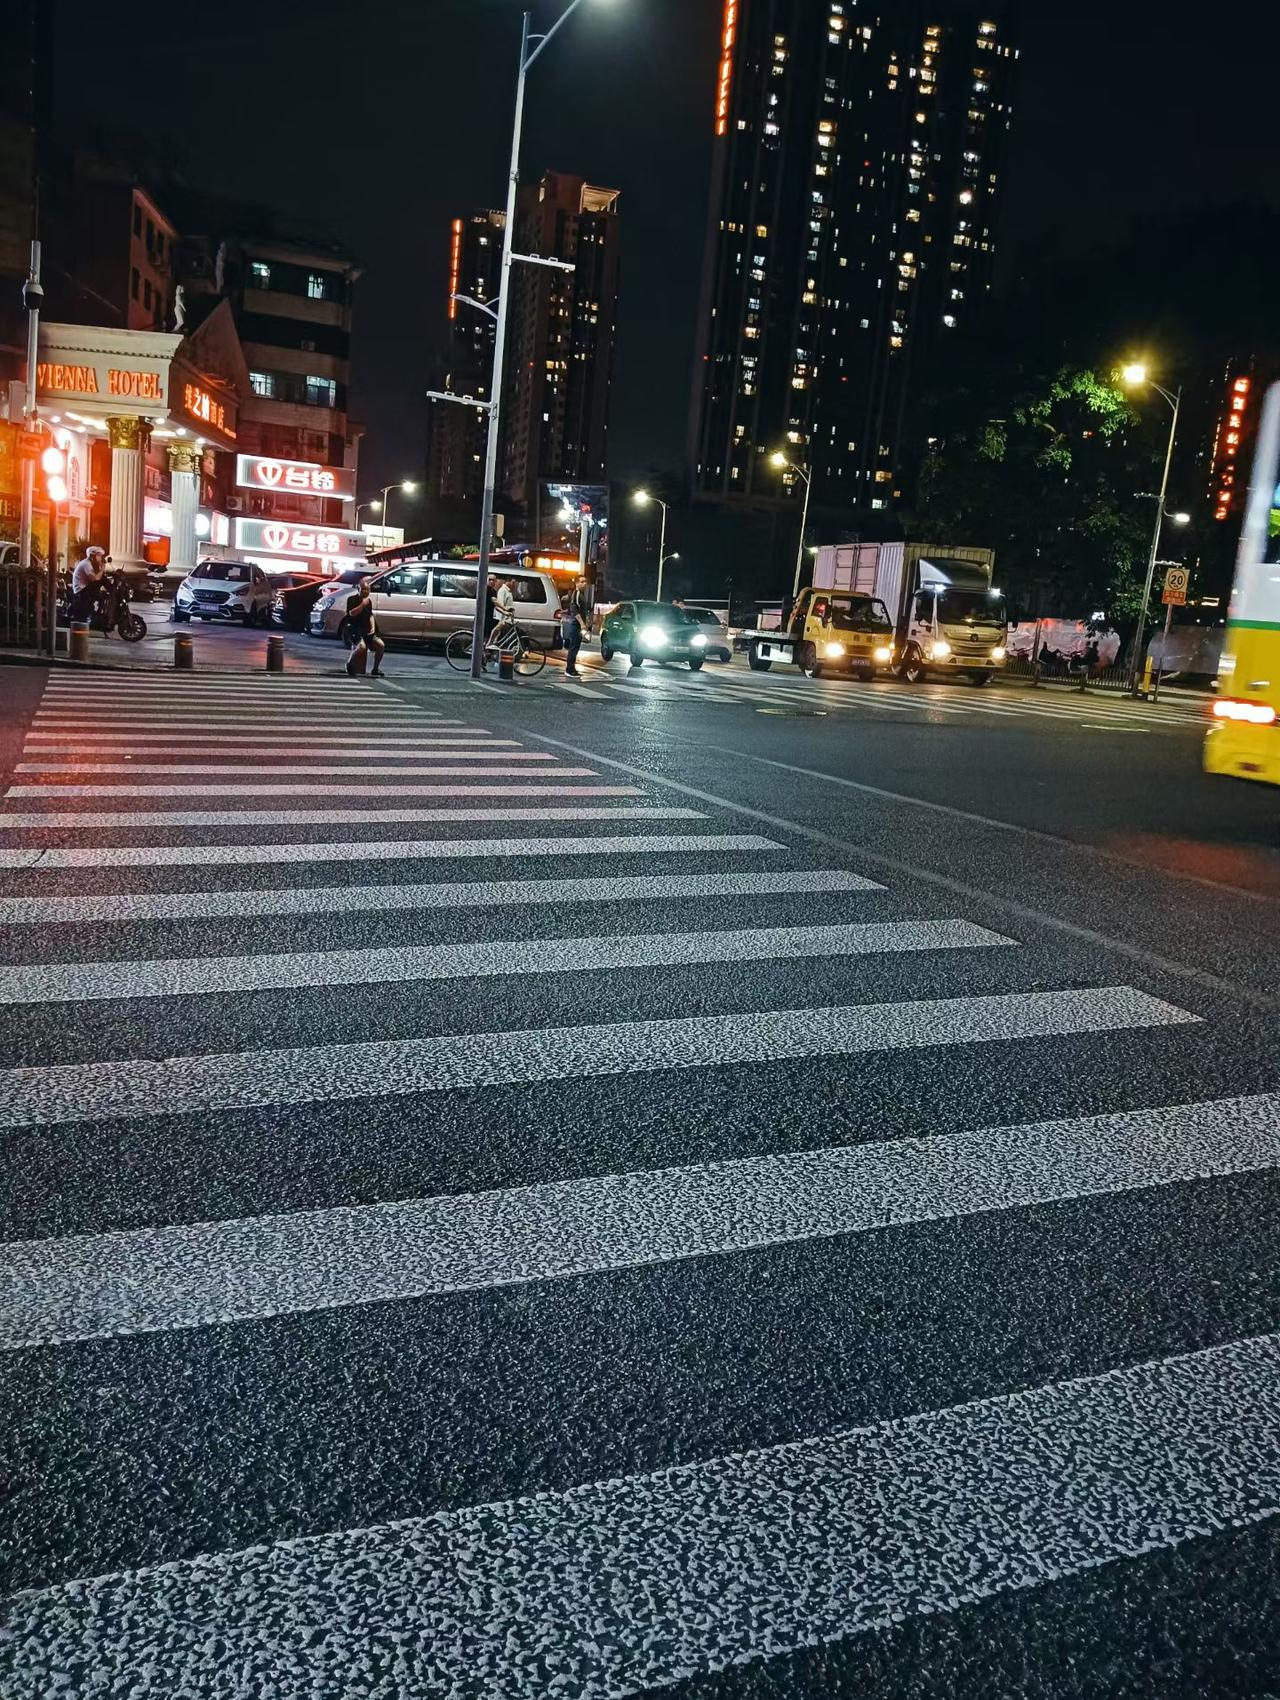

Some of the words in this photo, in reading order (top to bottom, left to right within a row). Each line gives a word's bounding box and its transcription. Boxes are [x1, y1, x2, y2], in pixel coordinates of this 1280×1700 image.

[38, 364, 98, 393] VIENNA
[108, 370, 163, 399] HOTEL
[285, 467, 335, 490] 台铃
[292, 531, 340, 553] 台铃
[1170, 574, 1184, 585] 20
